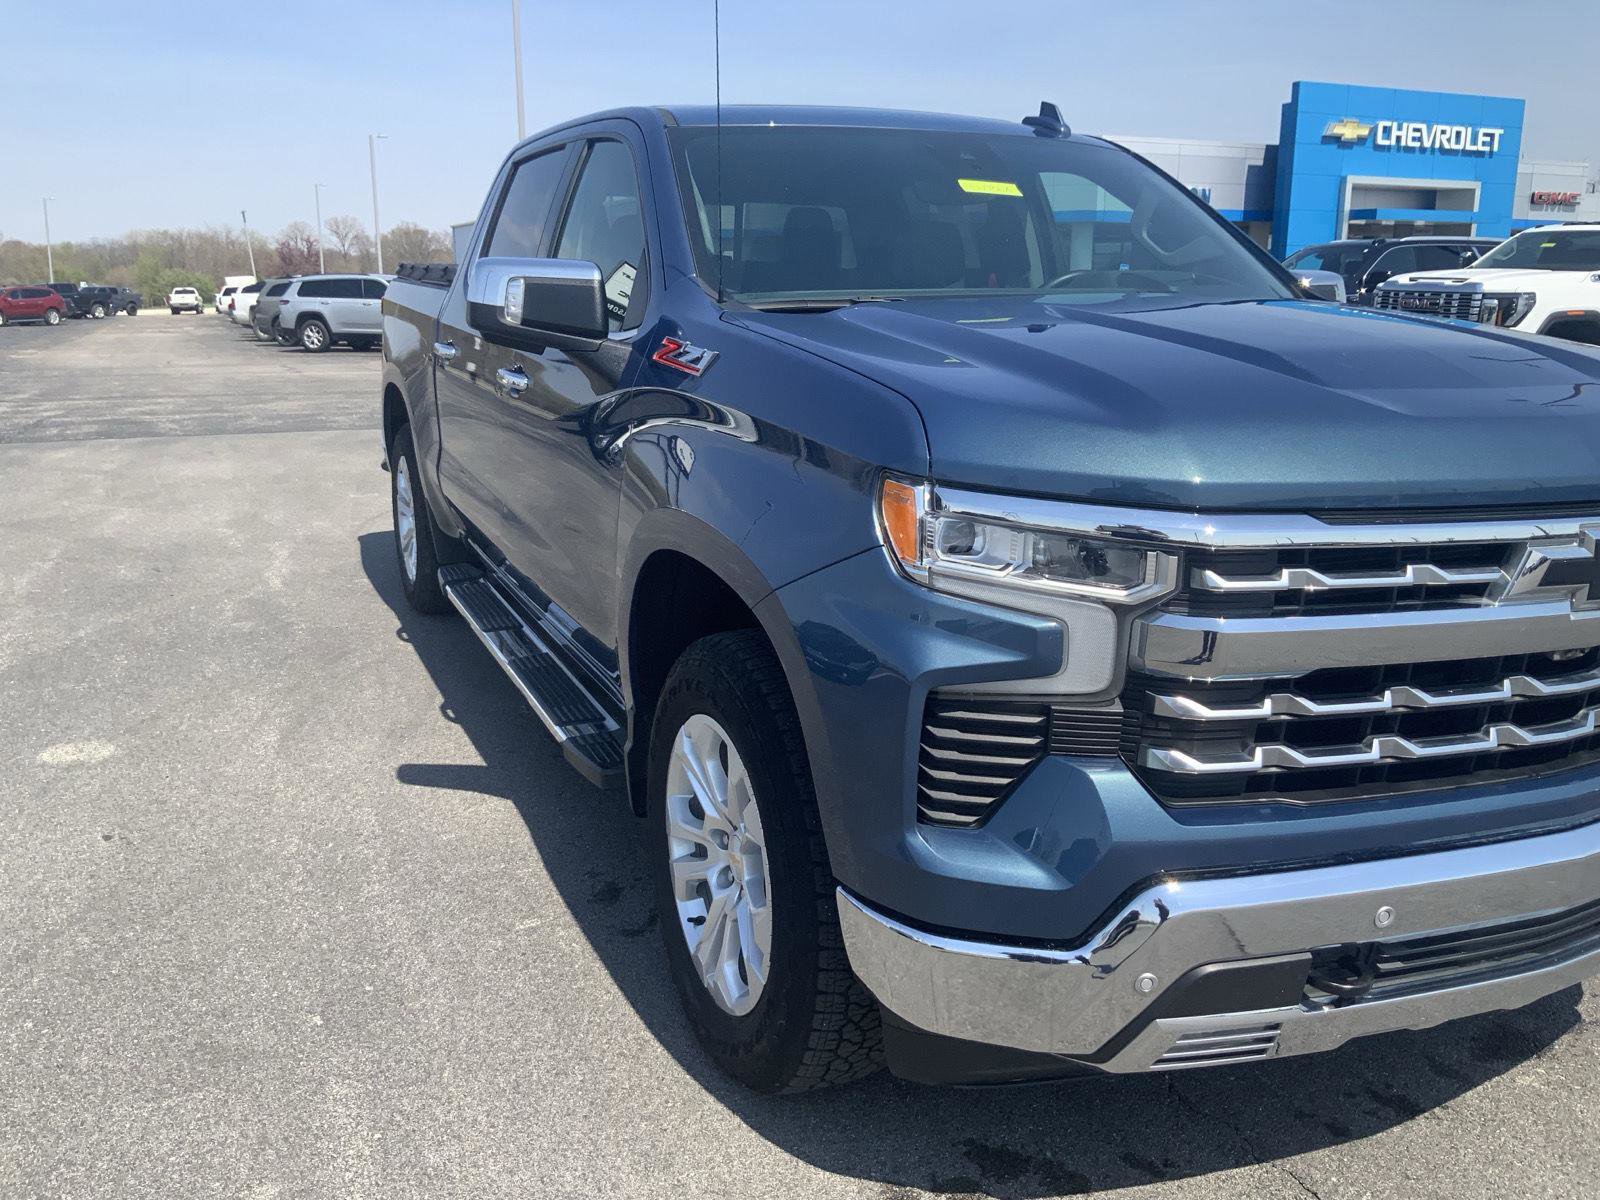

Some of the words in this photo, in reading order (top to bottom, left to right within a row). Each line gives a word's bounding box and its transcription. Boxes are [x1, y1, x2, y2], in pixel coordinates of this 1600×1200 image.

[1376, 120, 1504, 152] CHEVROLET
[1532, 191, 1581, 206] GMC
[653, 336, 719, 377] Z71
